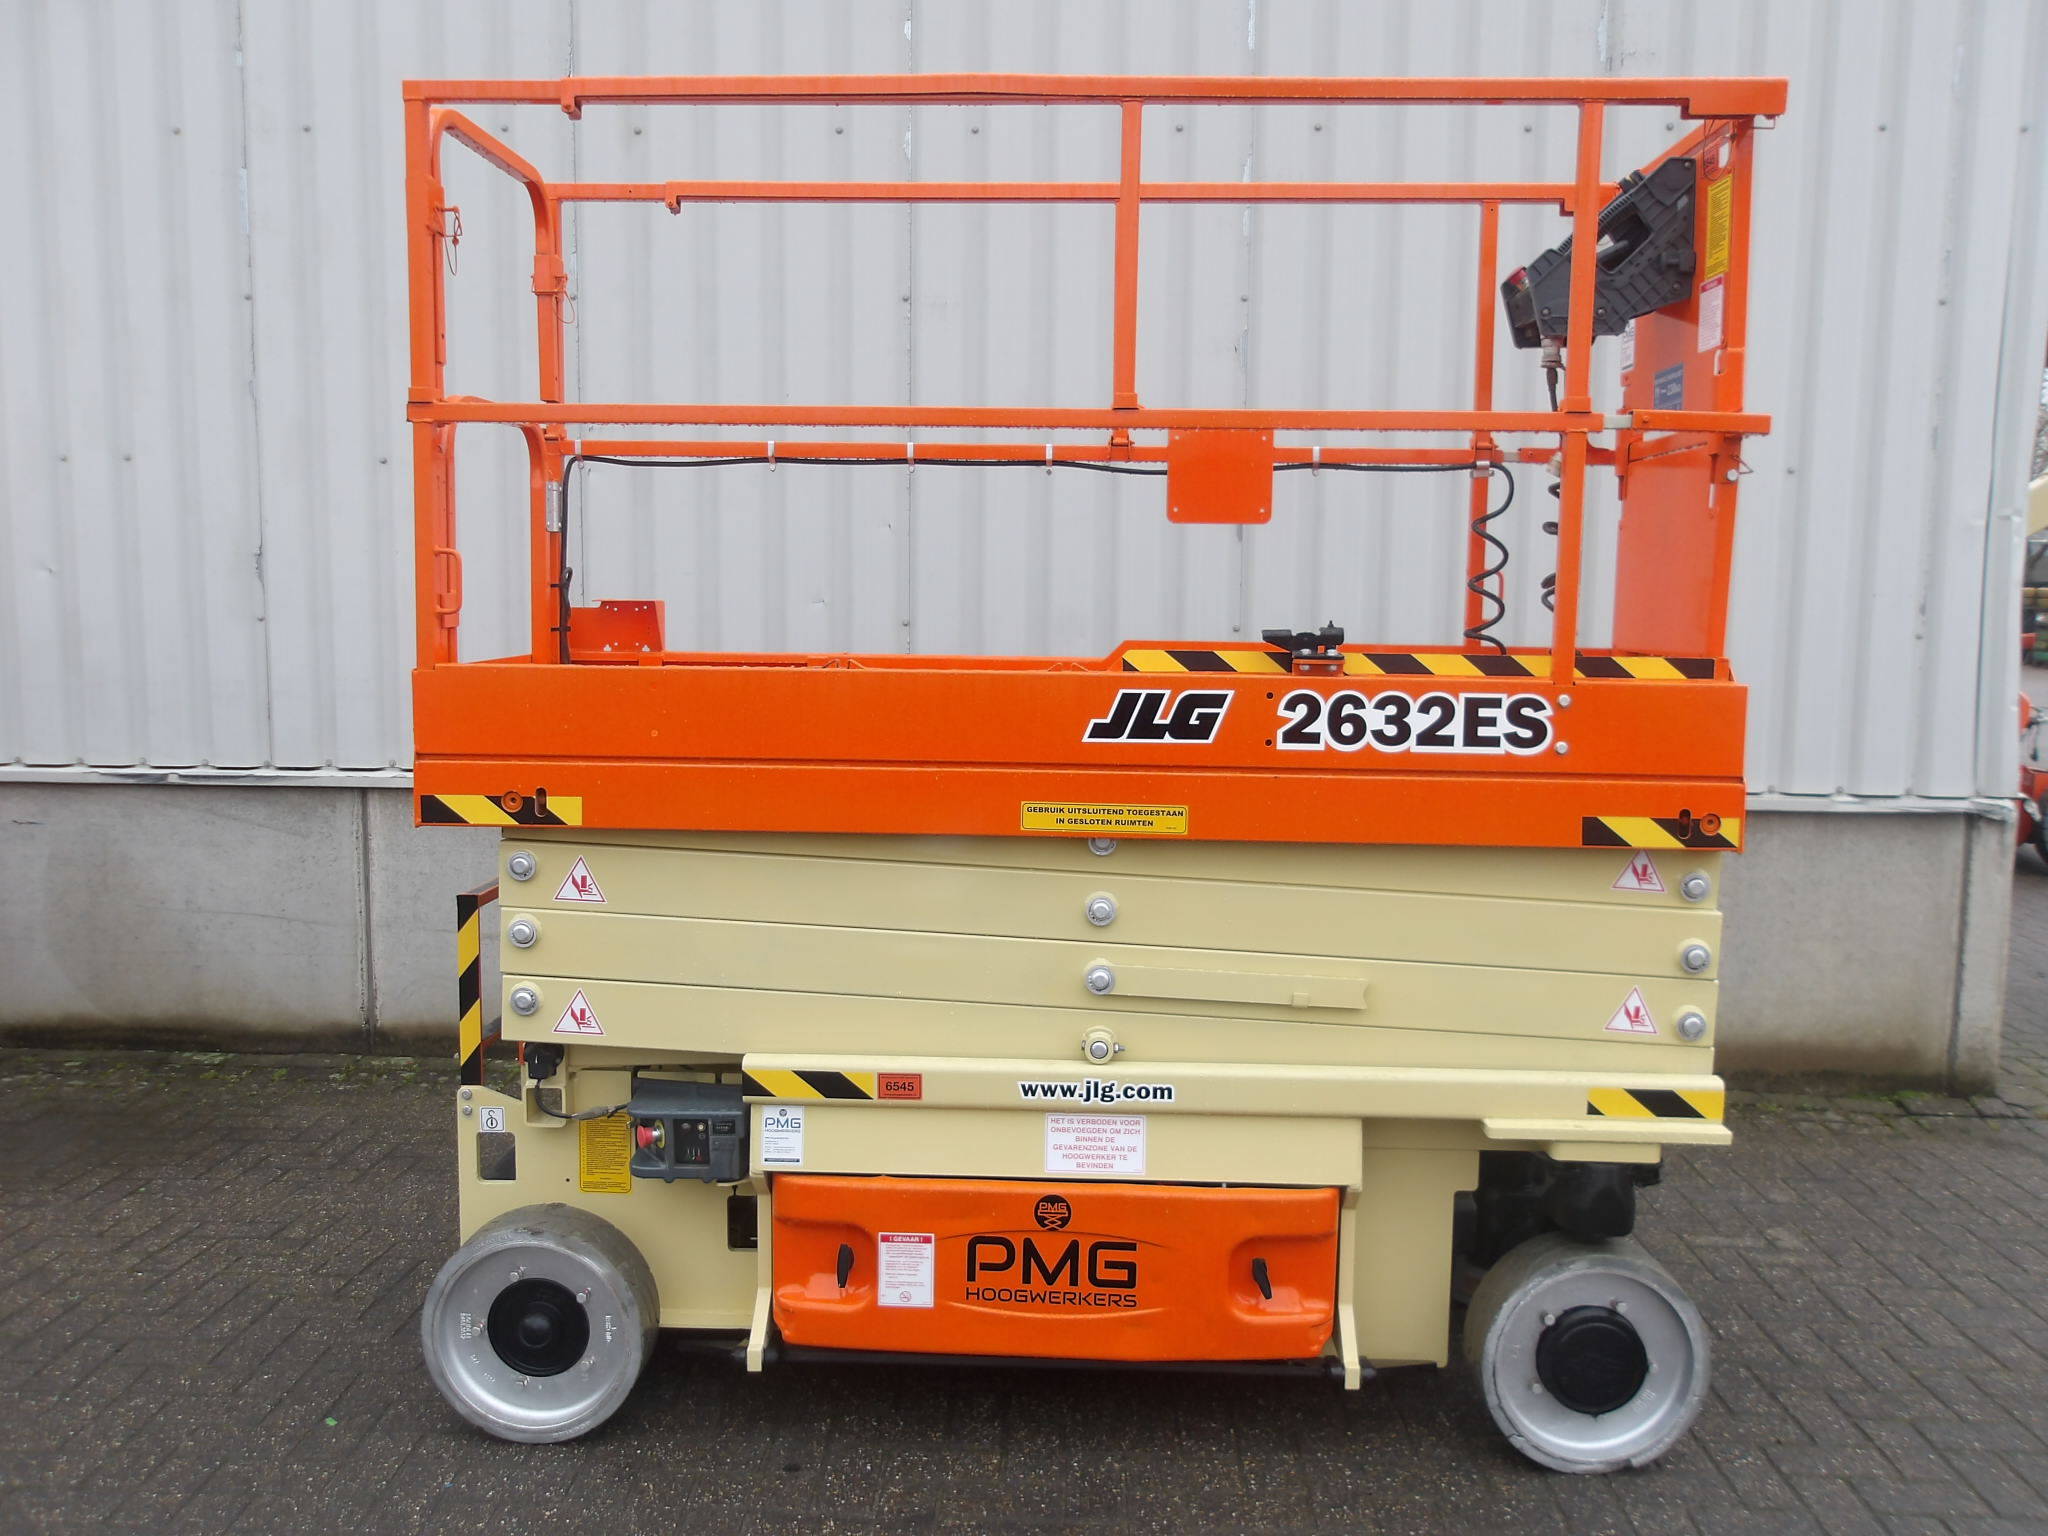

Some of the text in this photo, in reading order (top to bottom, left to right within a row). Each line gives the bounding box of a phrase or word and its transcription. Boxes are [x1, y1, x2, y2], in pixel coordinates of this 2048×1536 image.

[1085, 691, 1231, 742] JLG
[1280, 691, 1549, 748] 2632ES
[1026, 806, 1184, 817] GEBRUIK UITSLUITEND TOEGESTAAN
[1067, 818, 1112, 826] GESLOTEN
[1115, 819, 1154, 827] RUIMTEN
[885, 1081, 914, 1092] 6545
[1020, 1080, 1173, 1103] www.jlg.com
[764, 1117, 801, 1129] PMG
[1050, 1117, 1065, 1125] HET
[1076, 1118, 1117, 1126] VERBODEN
[1050, 1126, 1107, 1134] ONBEVOEGDEN
[1109, 1127, 1122, 1135] OM
[1075, 1135, 1103, 1143] BINNEN
[1052, 1143, 1108, 1152] GEVARENZONE
[1062, 1152, 1117, 1161] HOOGWERKER
[1075, 1161, 1114, 1169] BEVINDEN
[1039, 1202, 1067, 1211] PMG
[967, 1235, 1138, 1289] PMG
[966, 1286, 1138, 1308] HOOGWERKERS
